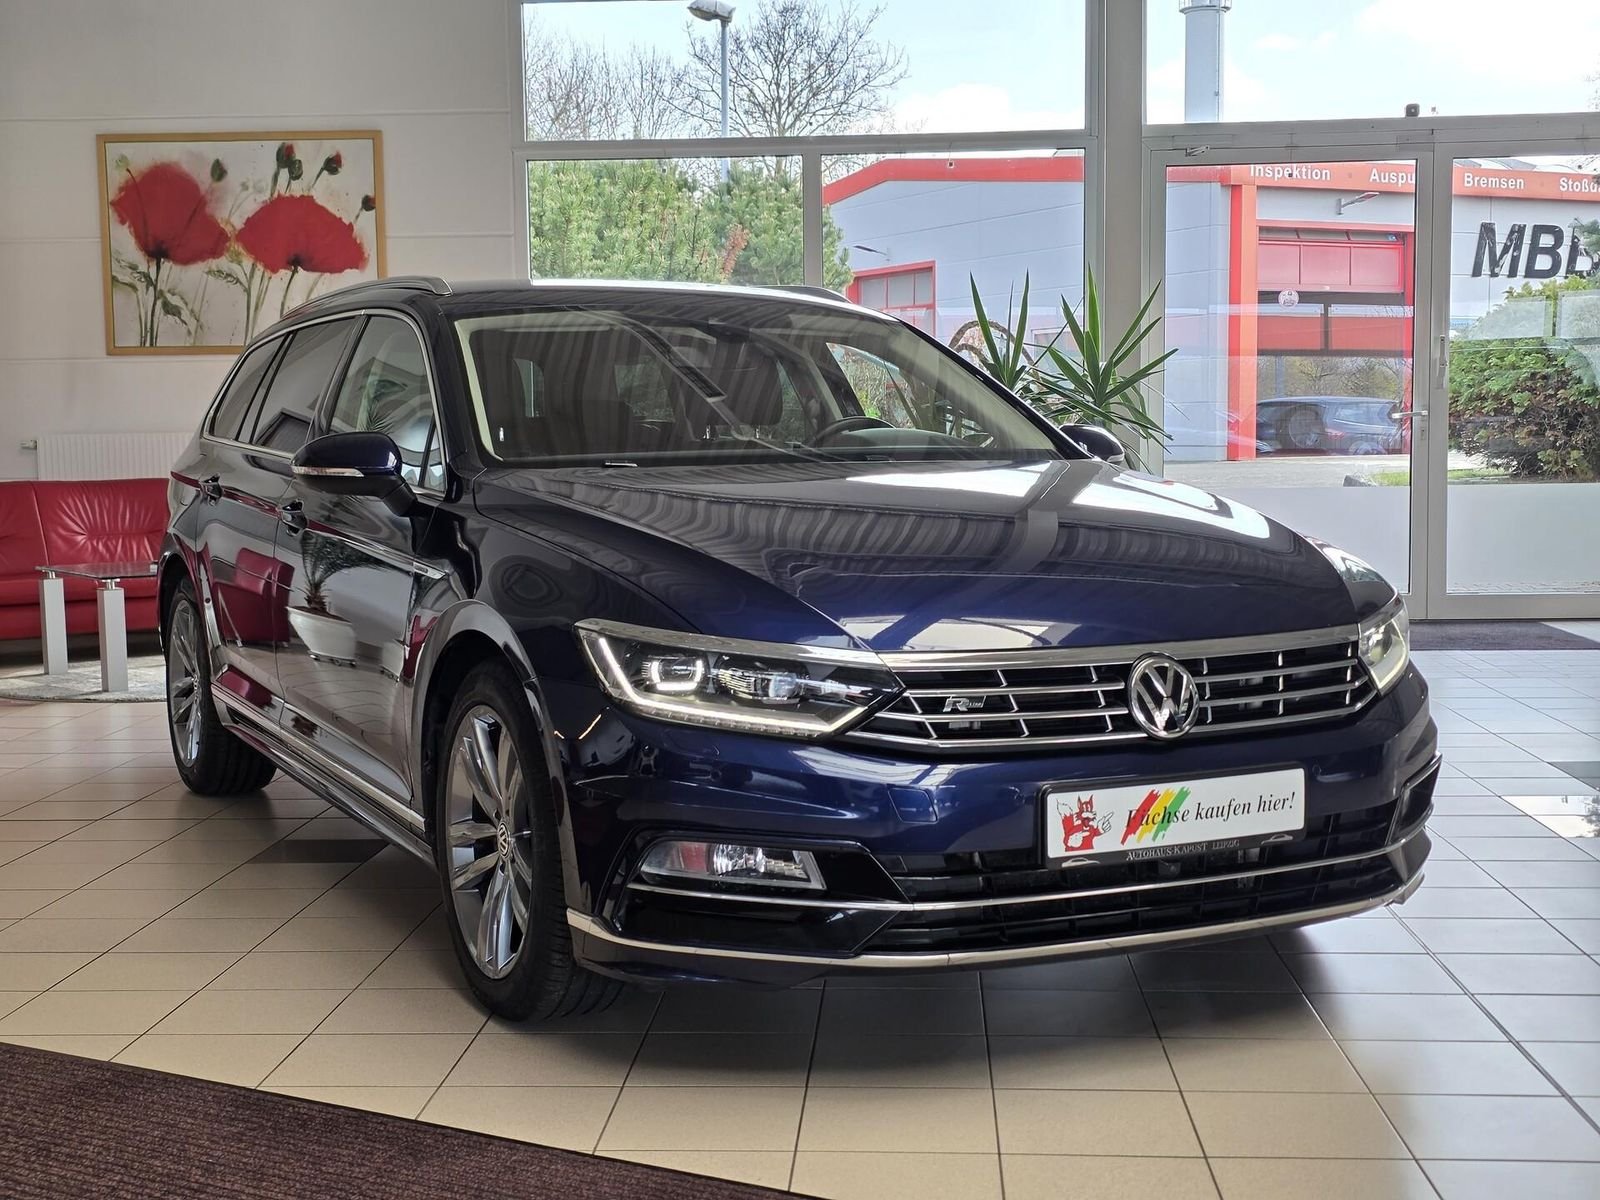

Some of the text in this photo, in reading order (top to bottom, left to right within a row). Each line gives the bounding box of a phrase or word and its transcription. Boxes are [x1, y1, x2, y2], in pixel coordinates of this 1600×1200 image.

[1250, 164, 1331, 182] Inspektion
[1464, 172, 1525, 189] Bremsen
[1126, 791, 1296, 828] Füchse kaufen hier!
